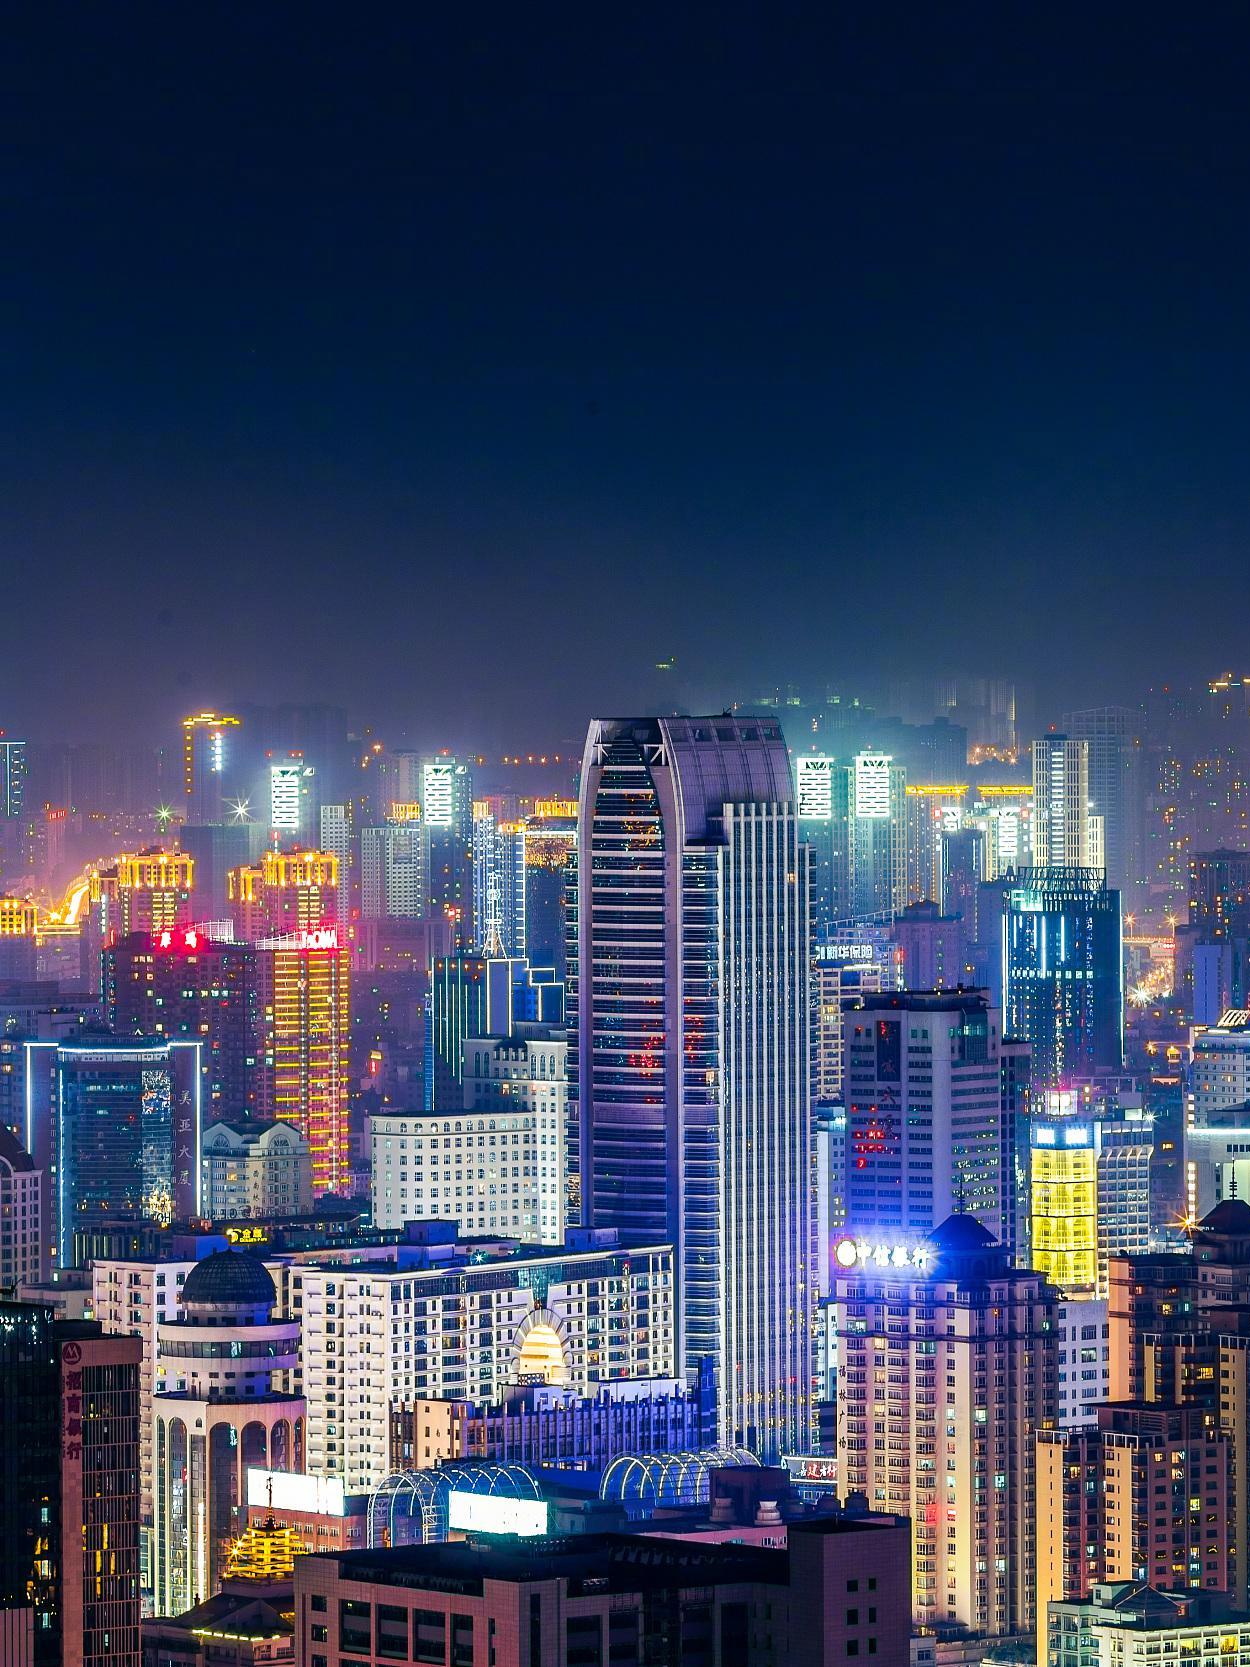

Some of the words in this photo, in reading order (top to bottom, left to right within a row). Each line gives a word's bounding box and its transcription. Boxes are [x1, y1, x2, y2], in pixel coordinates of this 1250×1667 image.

[826, 944, 874, 960] 新华保险
[178, 1089, 193, 1187] 美亚大厦
[856, 1240, 931, 1270] 中信银行
[65, 1370, 82, 1460] 招商银行
